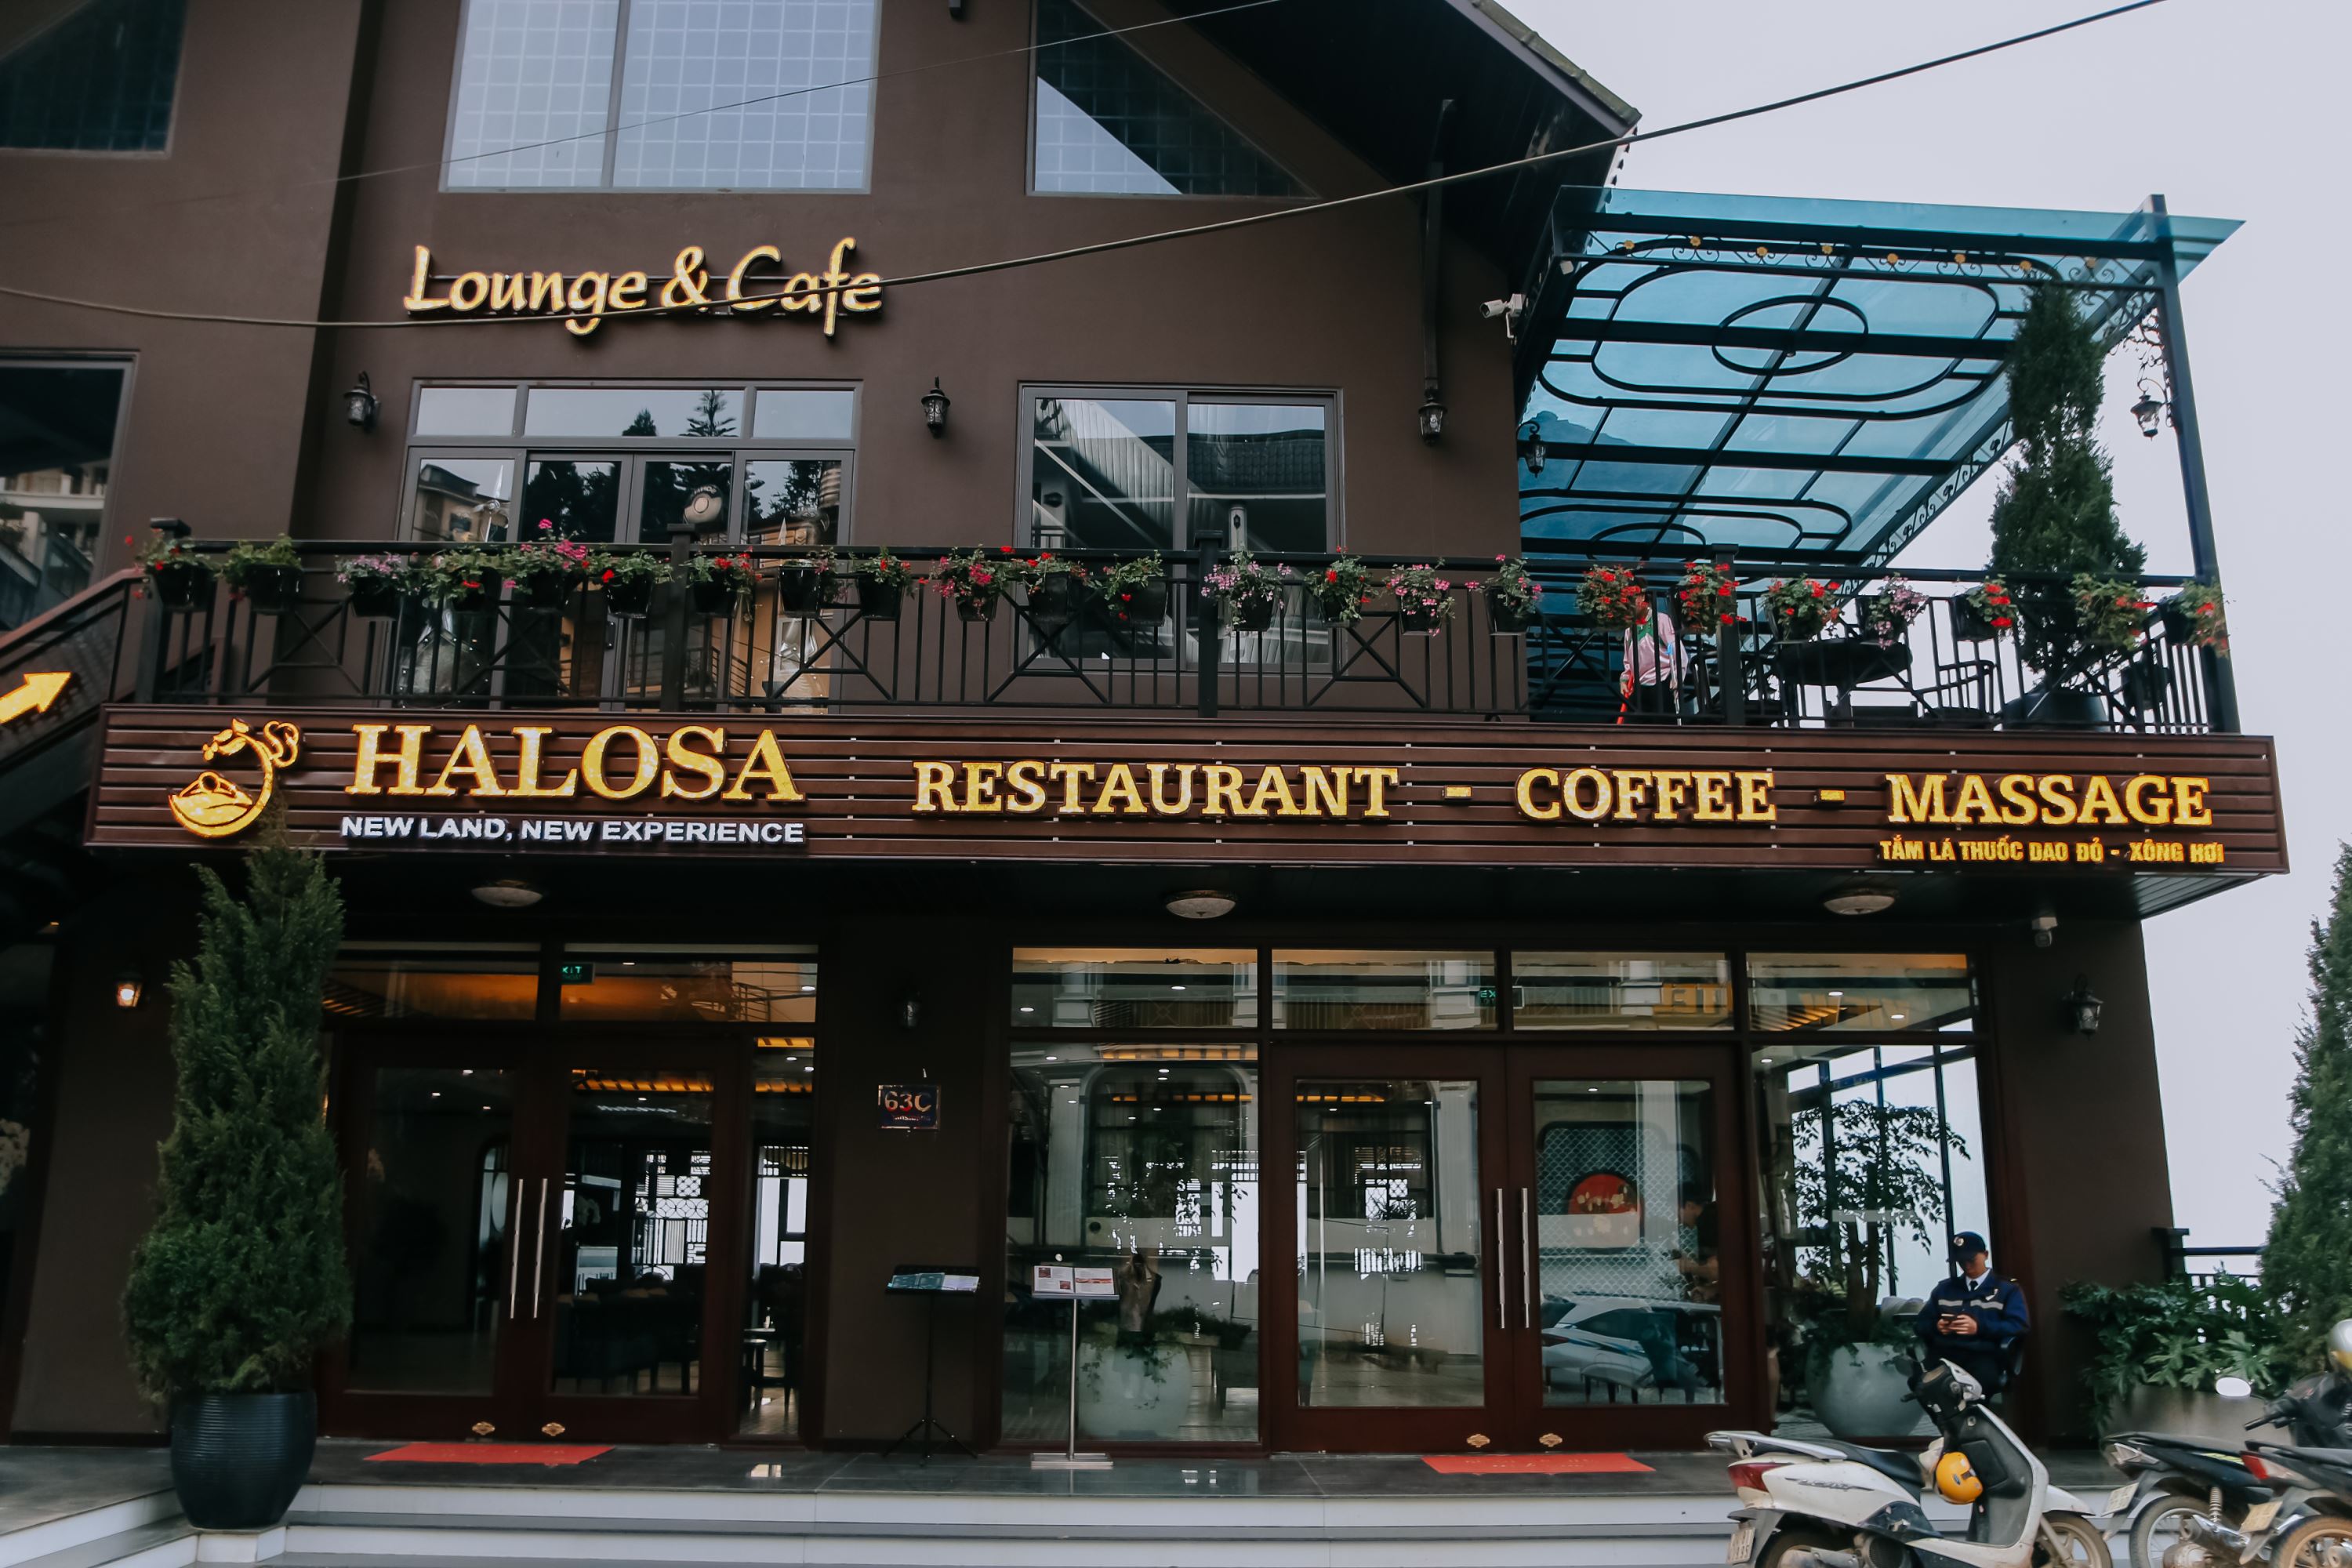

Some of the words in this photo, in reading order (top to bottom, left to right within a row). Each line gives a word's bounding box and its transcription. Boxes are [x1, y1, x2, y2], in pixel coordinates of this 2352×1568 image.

[403, 245, 648, 336] Lounge
[661, 245, 710, 312] &
[726, 237, 884, 336] Cafe
[345, 724, 807, 801] HALOSA
[911, 760, 1399, 818] RESTAURANT
[1516, 767, 1777, 822] COFFEE
[1885, 774, 2212, 826] MASSAGE
[341, 815, 415, 837] NEW
[420, 817, 514, 841] LAND,
[521, 819, 593, 840] NEW
[601, 820, 804, 844] EXPERIENCE
[1879, 833, 1925, 861] TẮM
[1929, 837, 1956, 861] LÁ
[1958, 834, 2024, 861] THUỐC
[2029, 841, 2070, 862] DAO
[2076, 837, 2104, 862] ĐỎ
[2128, 839, 2186, 862] XÔNG
[2189, 841, 2225, 863] HƠI
